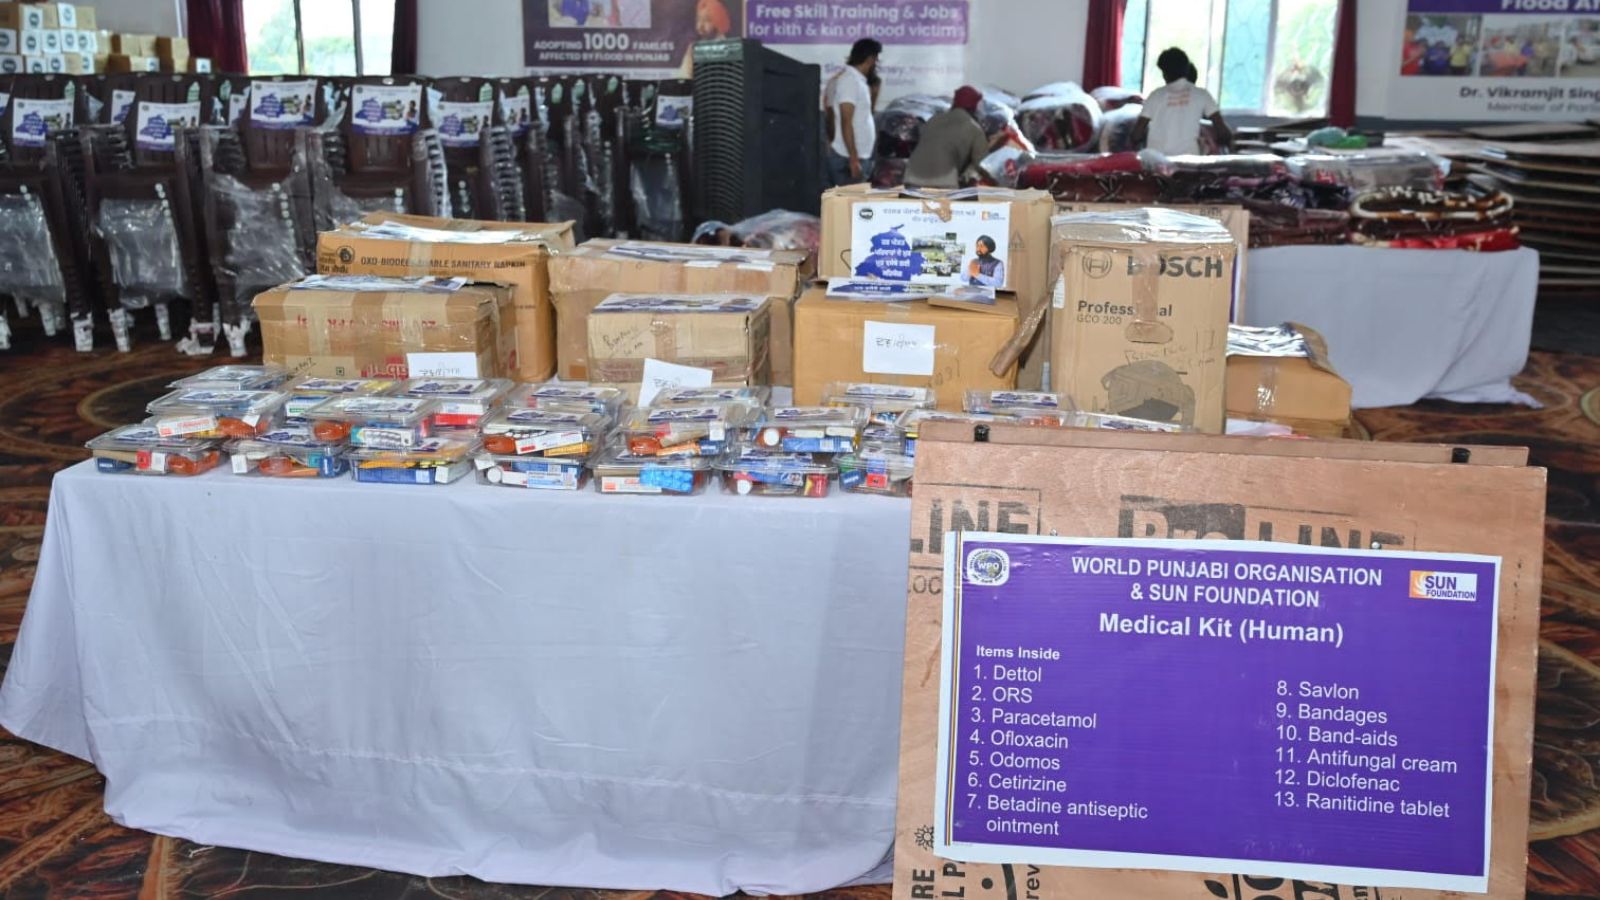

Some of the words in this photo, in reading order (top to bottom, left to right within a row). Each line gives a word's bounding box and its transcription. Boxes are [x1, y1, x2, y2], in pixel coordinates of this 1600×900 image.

[756, 4, 791, 18] Free
[794, 4, 827, 18] Skill
[832, 4, 899, 22] Training
[902, 6, 914, 18] &
[919, 5, 958, 19] Jobs
[749, 23, 770, 36] for
[773, 21, 802, 36] kith
[806, 23, 818, 36] &
[821, 22, 843, 36] kin
[846, 22, 861, 36] of
[864, 22, 906, 37] flood
[908, 23, 966, 37] victims
[534, 40, 583, 50] ADOPTING
[583, 33, 630, 50] 1000
[1459, 87, 1482, 98] Dr.
[1487, 86, 1564, 101] Vikramjit
[1487, 101, 1546, 112] Member
[451, 258, 491, 269] SANITARY
[1127, 256, 1223, 278] SCH
[1077, 300, 1172, 317] Professal
[1103, 315, 1122, 325] 200
[911, 499, 1029, 553] INE
[977, 559, 999, 571] WPO
[1071, 556, 1142, 576] WORLD
[1147, 559, 1229, 580] PUNJABI
[1234, 562, 1383, 586] ORGANISATION
[1425, 576, 1457, 591] SUN
[1130, 583, 1144, 600] &
[1149, 583, 1188, 602] SUN
[1194, 585, 1320, 608] FOUNDATION
[1426, 589, 1476, 600] FOUNDATION
[1099, 612, 1191, 636] Medical
[1199, 617, 1233, 637] Kit
[1239, 618, 1345, 648] (Human)
[976, 645, 1014, 659] Items
[1018, 647, 1060, 661] Inside
[973, 664, 988, 681] 1.
[993, 665, 1042, 682] Dettol
[971, 686, 986, 702] 2.
[992, 686, 1033, 704] ORS
[1276, 680, 1292, 696] 8.
[1299, 681, 1359, 700] Savlon
[970, 707, 985, 723] 3.
[991, 708, 1097, 729] Paracetamol
[1275, 702, 1292, 718] 9.
[1298, 703, 1388, 726] Bandages
[969, 729, 985, 745] 4.
[990, 730, 1069, 749] Ofloxacin
[1276, 725, 1302, 742] 10.
[1308, 726, 1399, 747] Band-aids
[969, 751, 984, 766] 5.
[990, 751, 1060, 770] Odomos
[1275, 747, 1301, 763] 11.
[1307, 748, 1396, 772] Antifungal
[1401, 757, 1458, 774] cream
[967, 773, 982, 788] 6.
[988, 773, 1067, 793] Cetirizine
[1274, 769, 1300, 785] 12.
[1307, 770, 1401, 792] Diclofenac
[967, 794, 981, 810] 7.
[987, 794, 1062, 815] Betadine
[1067, 798, 1149, 821] antiseptic
[1274, 791, 1299, 808] 13.
[1306, 793, 1395, 814] Ranitidine
[1400, 799, 1450, 818] tablet
[986, 817, 1060, 837] ointment
